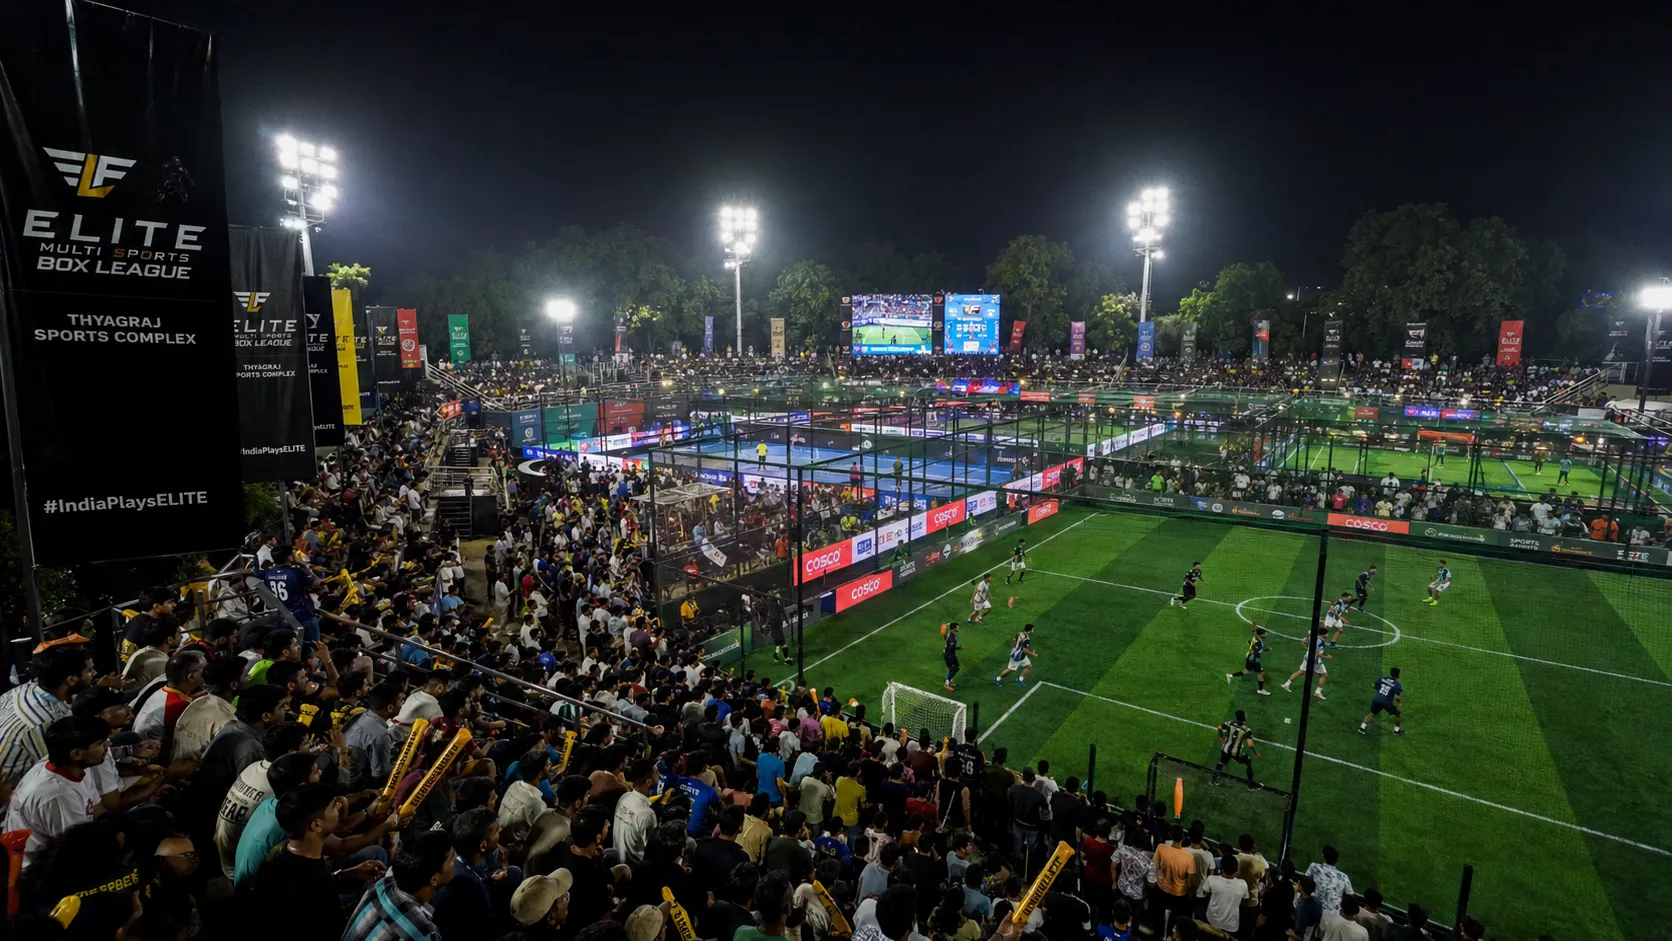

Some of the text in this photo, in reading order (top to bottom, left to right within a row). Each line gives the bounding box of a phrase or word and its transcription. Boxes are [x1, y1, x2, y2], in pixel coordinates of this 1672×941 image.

[22, 208, 207, 251] ELITE
[39, 242, 190, 263] MULTI SPORTS
[36, 255, 193, 280] BOX LEAGUE
[66, 313, 162, 328] THYAGRAJ
[34, 328, 197, 345] SPORTS COMPLEX
[43, 491, 208, 514] #IndiaPlaysELITE
[1345, 518, 1389, 532] COSCO
[805, 547, 843, 574] COSCO
[851, 577, 882, 600] COSCO
